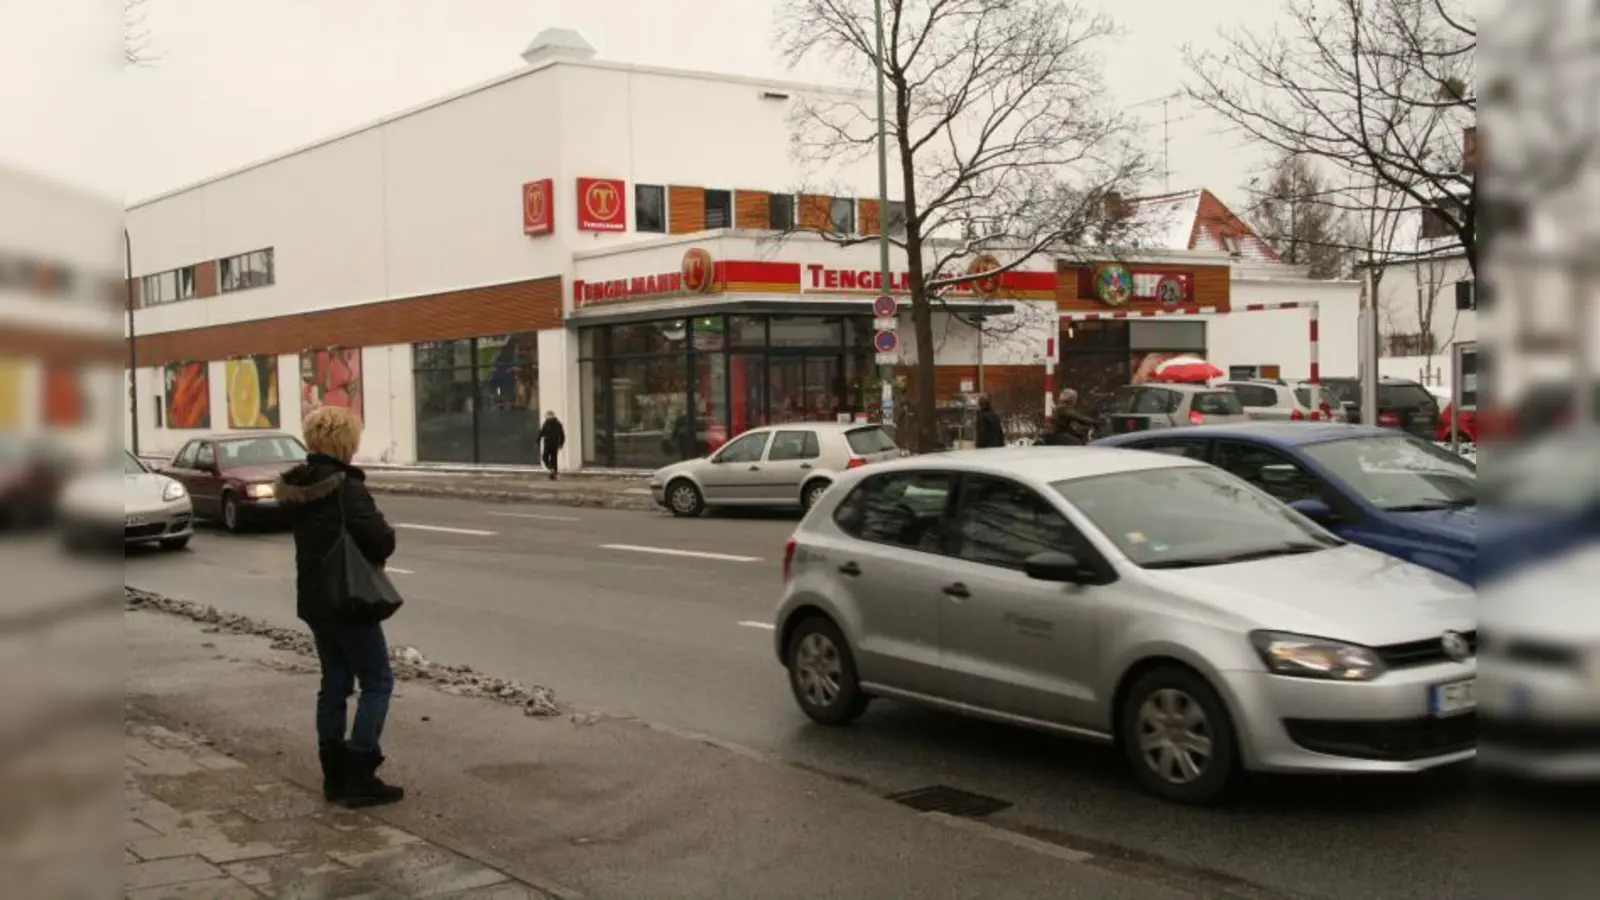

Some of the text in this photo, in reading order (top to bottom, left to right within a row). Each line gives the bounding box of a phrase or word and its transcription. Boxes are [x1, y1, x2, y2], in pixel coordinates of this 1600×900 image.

[592, 188, 615, 214] T
[573, 271, 681, 301] TENGELMANN
[807, 264, 973, 291] TENGEL
